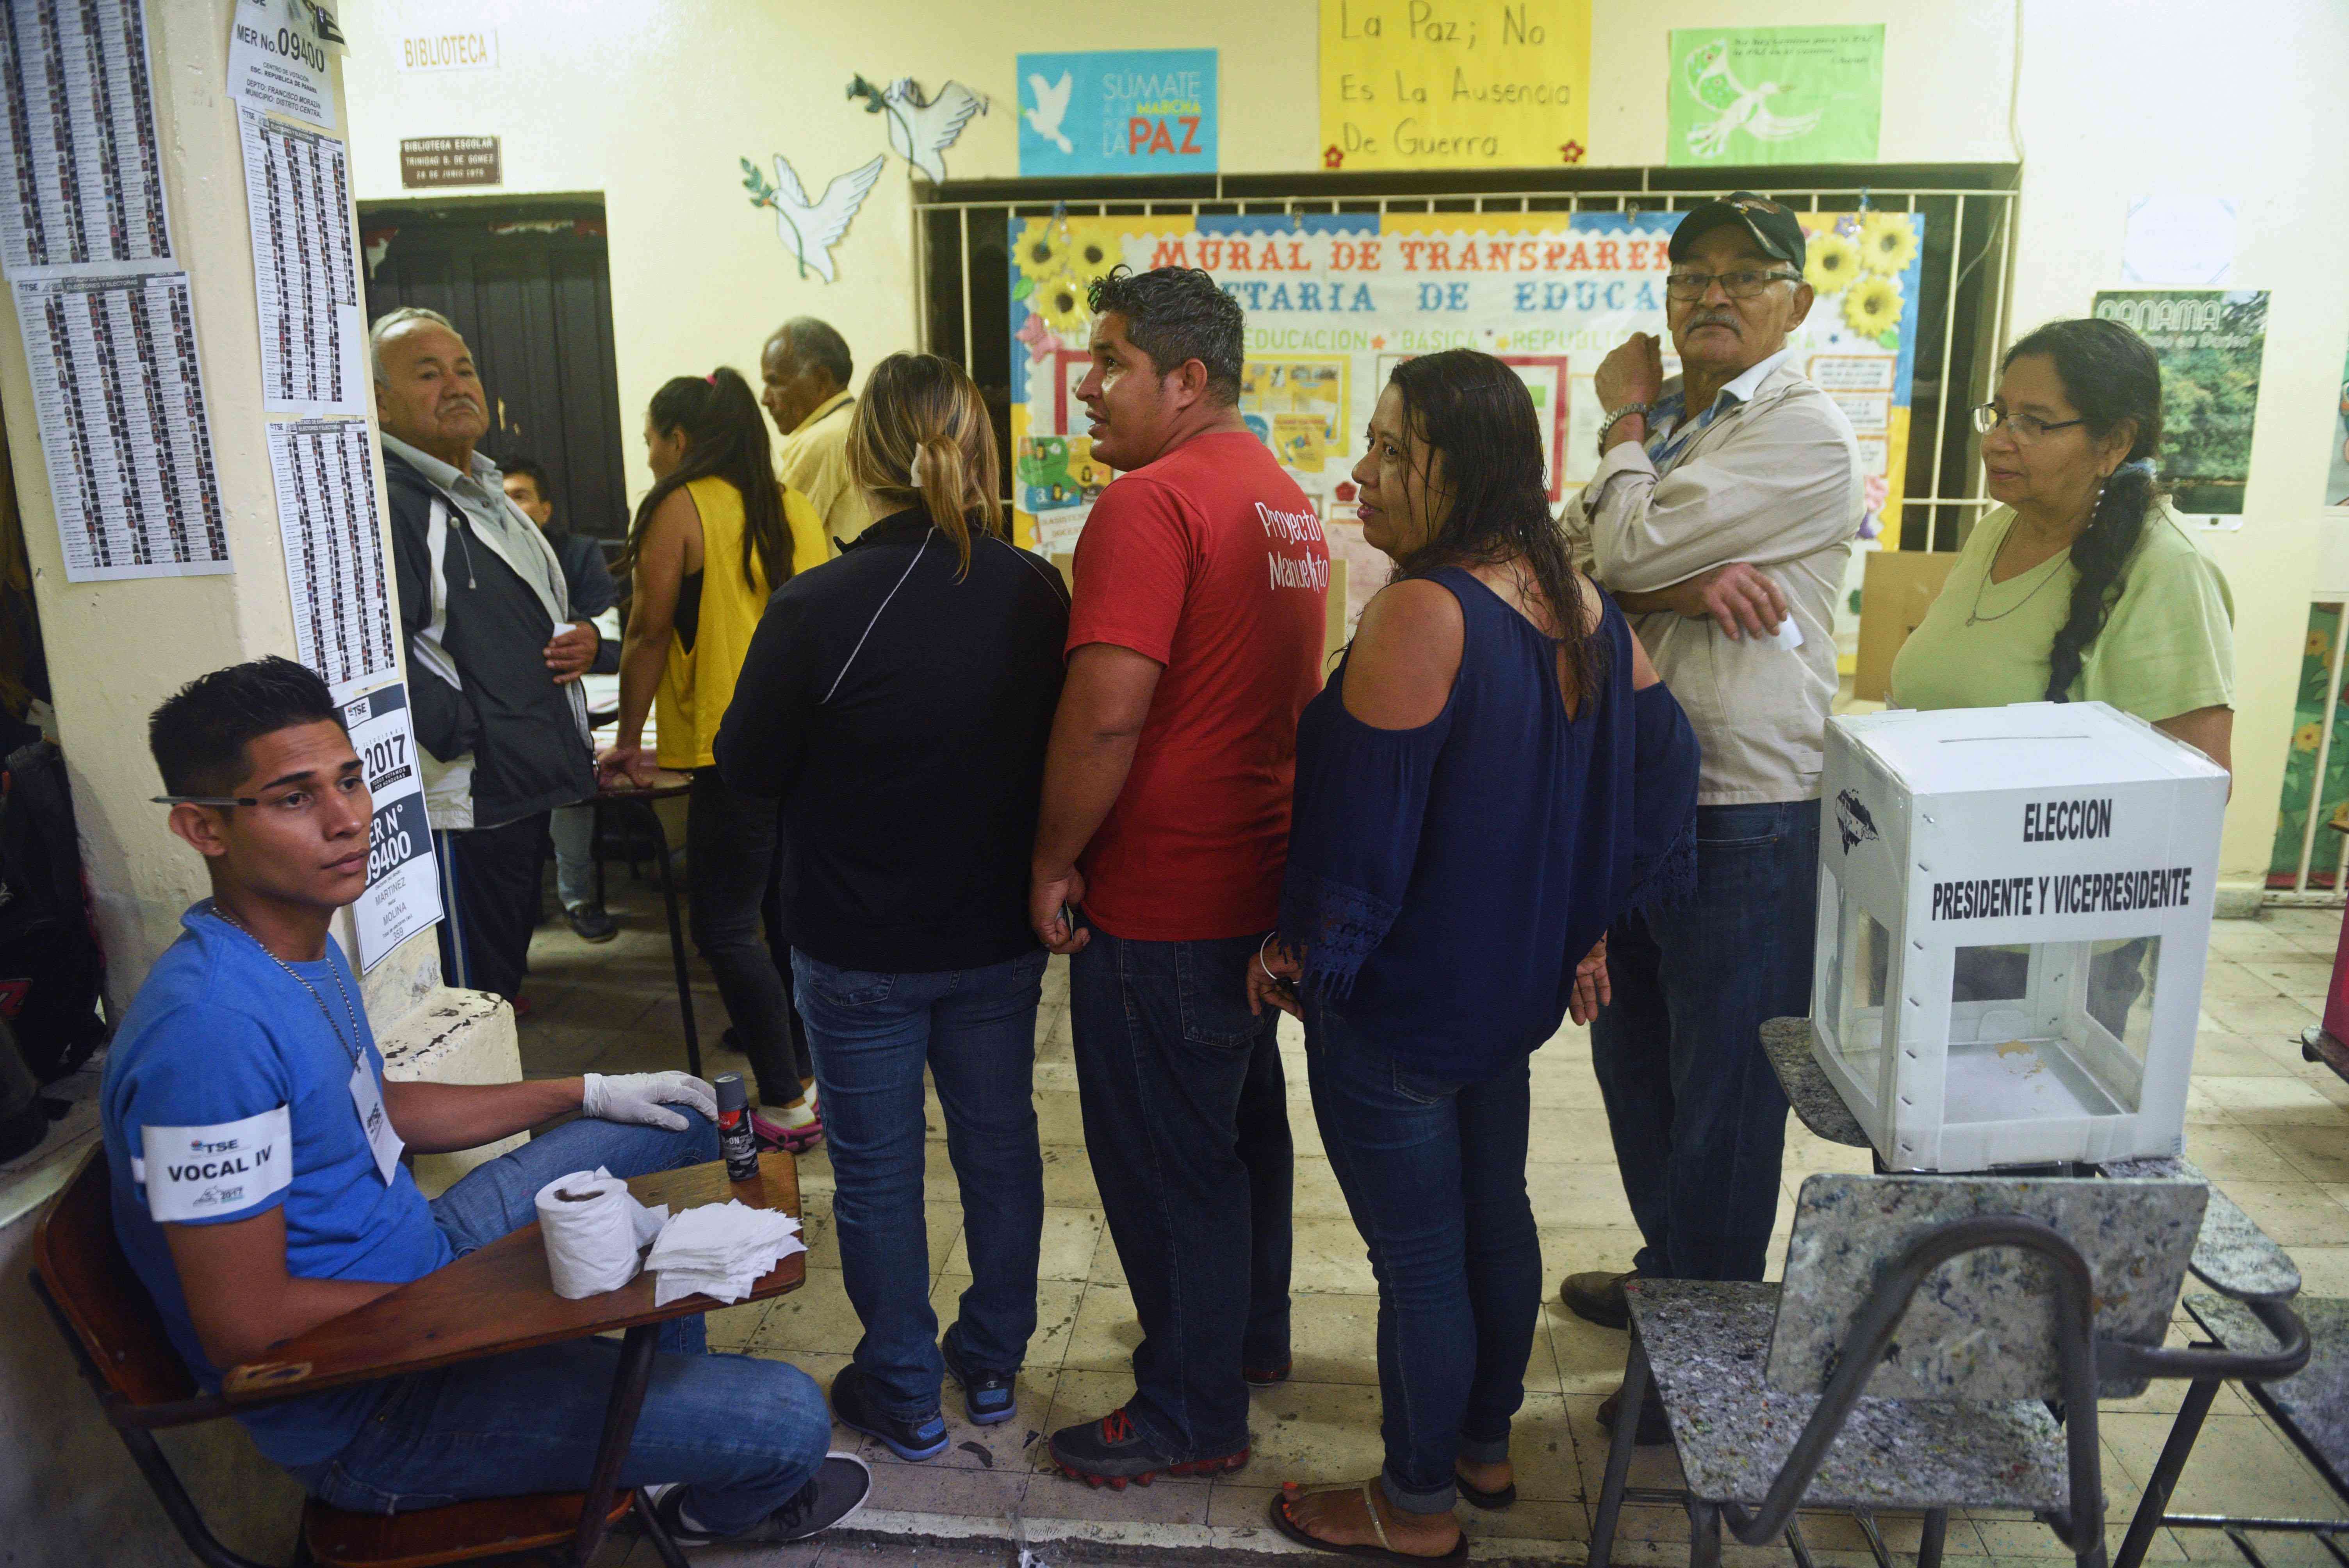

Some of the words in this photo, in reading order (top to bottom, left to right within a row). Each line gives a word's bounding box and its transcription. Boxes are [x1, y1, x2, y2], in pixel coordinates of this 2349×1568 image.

[1341, 0, 1382, 40] La
[1502, 4, 1545, 45] No
[237, 23, 257, 46] MER
[278, 28, 324, 73] 09400
[404, 33, 488, 67] BIBLIOTECA
[264, 70, 293, 85] REPUBLICA
[1340, 73, 1374, 102] Es
[1395, 69, 1427, 103] La
[1451, 66, 1570, 105] Ausencia
[268, 86, 298, 101] FRANCISCO
[276, 98, 298, 111] DISTRITO
[299, 105, 322, 118] CENTRAL
[1136, 100, 1202, 115] MARCHA
[404, 140, 451, 153] BIBLIOTECA
[454, 138, 494, 150] ESCOLAR
[1128, 116, 1202, 155] PAZ
[1343, 122, 1378, 153] De
[1394, 117, 1498, 156] Guerra
[1150, 239, 1312, 271] MURAL
[1329, 240, 1383, 271] DE
[1399, 240, 1672, 271] TRANSPAREN
[24, 282, 38, 291] TSE
[1418, 282, 1469, 311] DE
[1513, 281, 1666, 311] EDUCA
[1513, 330, 1632, 350] REPUBLIC
[1255, 502, 1321, 545] Proyecto
[353, 703, 367, 717] TSE
[365, 733, 405, 779] 2017
[385, 767, 406, 780] VOTAMOS
[369, 818, 385, 848] ER
[2023, 799, 2112, 843] ELECCION
[375, 877, 406, 906] MARTINEZ
[1932, 877, 2034, 921] PRESIDENTE
[2038, 876, 2051, 915] Y
[2052, 868, 2192, 914] VICEPRESIDENTE
[383, 902, 407, 926] MOLINA
[205, 1139, 238, 1153] TSE
[168, 1158, 250, 1182] VOCAL
[256, 1144, 272, 1166] IV
